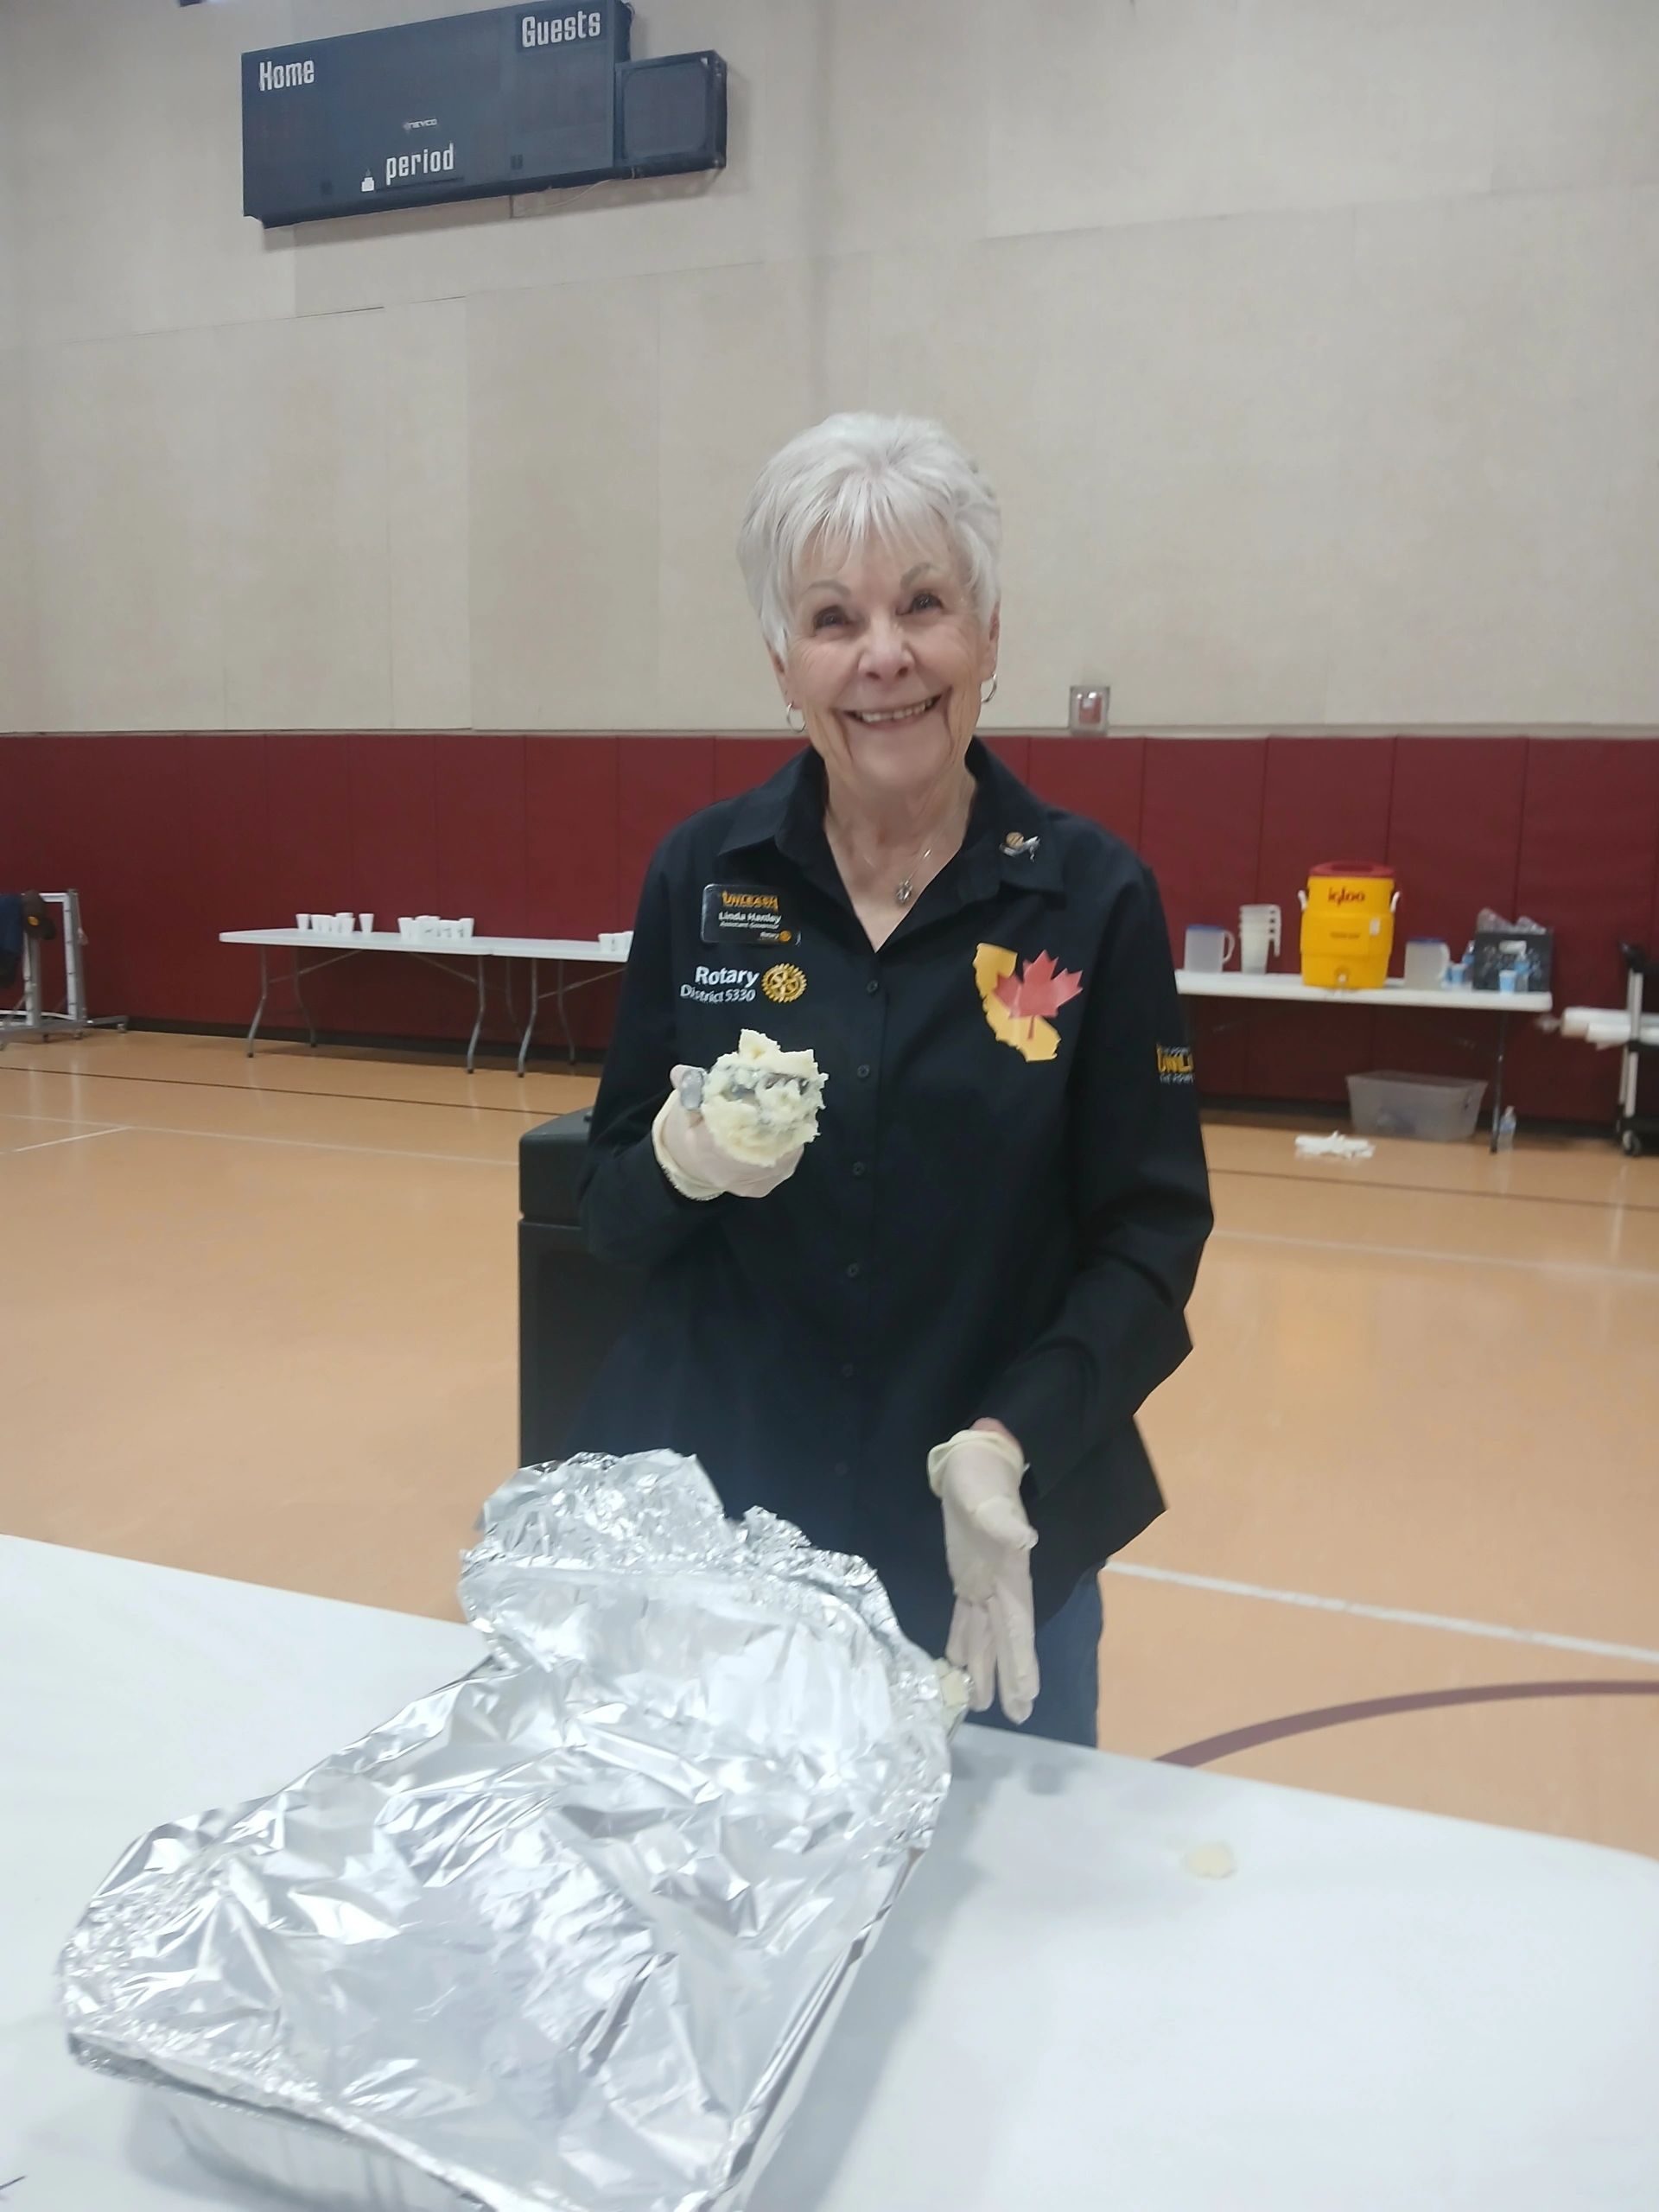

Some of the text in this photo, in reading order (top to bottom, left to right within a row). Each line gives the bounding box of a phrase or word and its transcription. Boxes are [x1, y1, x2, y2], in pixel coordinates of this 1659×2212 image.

[522, 10, 601, 48] Guests
[259, 60, 315, 92] Home
[385, 142, 454, 185] period
[1327, 887, 1365, 907] igloo
[718, 911, 746, 921] Linda
[695, 965, 760, 988] Rotary
[680, 984, 756, 1003] District 5330
